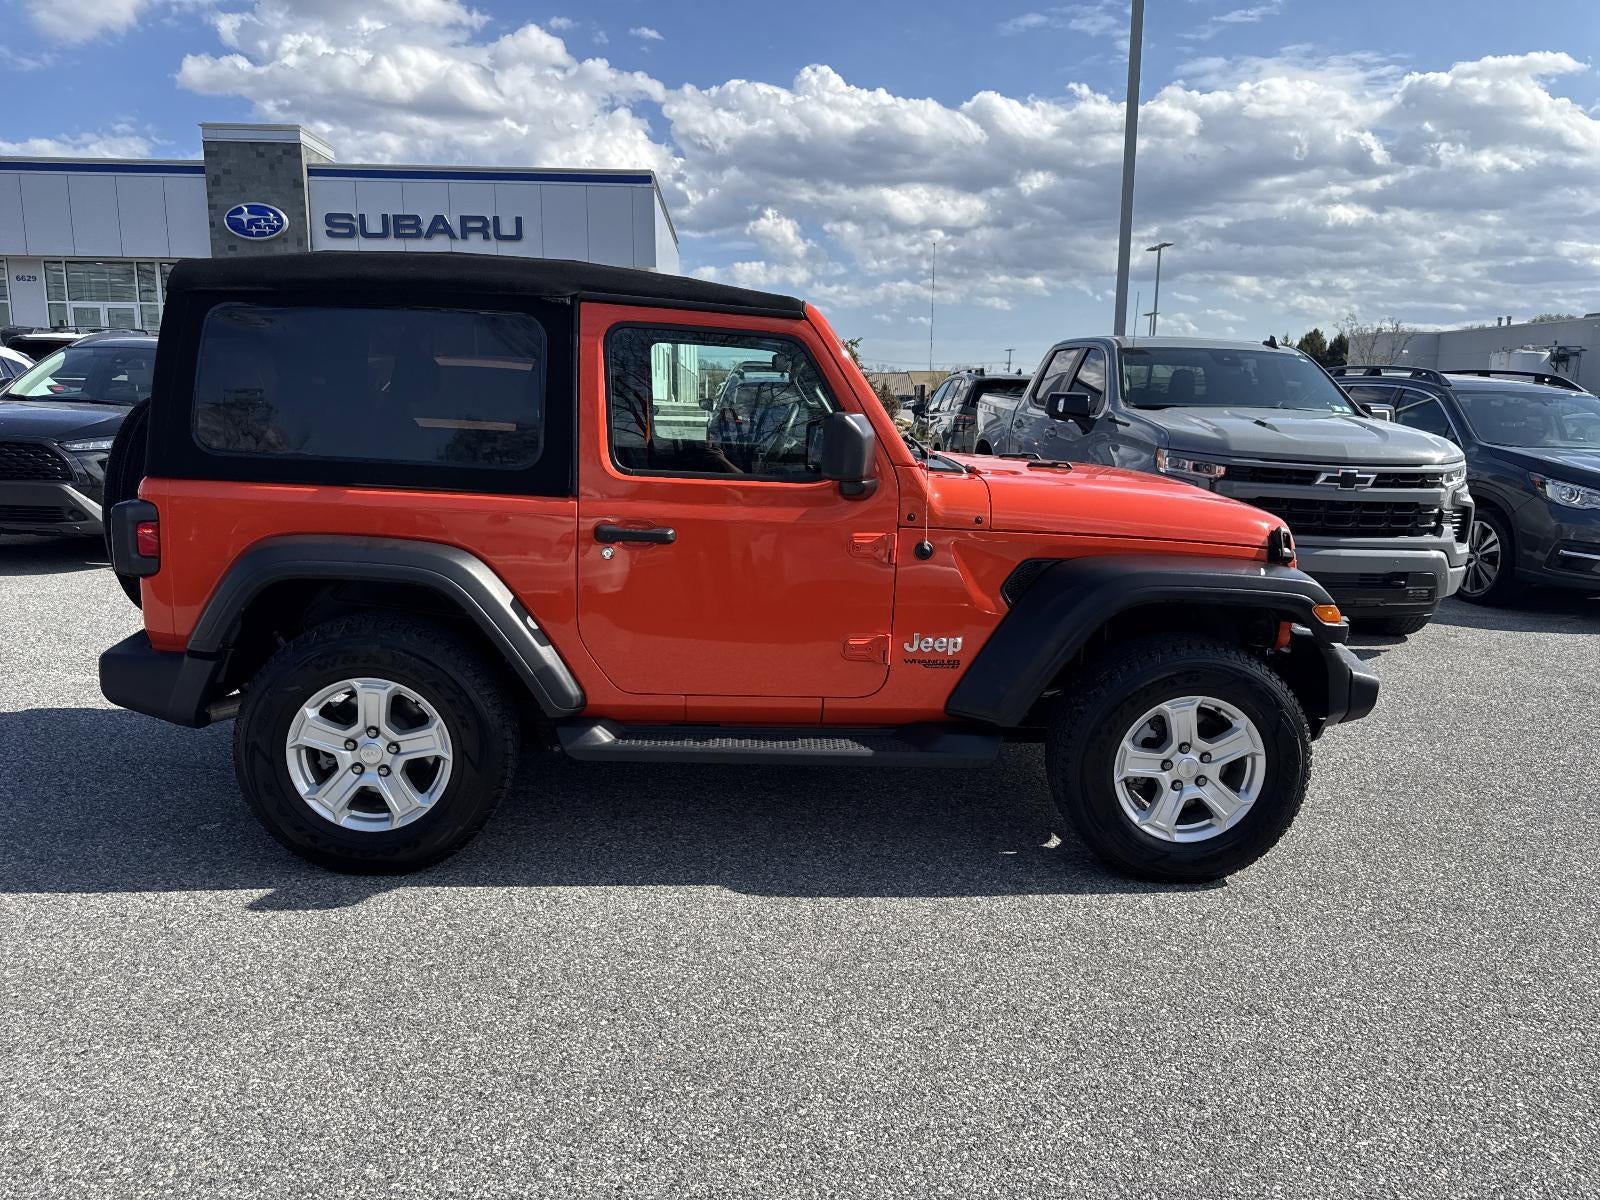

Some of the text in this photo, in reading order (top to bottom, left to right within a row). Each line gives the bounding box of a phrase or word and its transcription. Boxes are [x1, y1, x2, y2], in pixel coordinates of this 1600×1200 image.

[324, 212, 523, 241] SUBARU
[15, 274, 37, 282] 6629
[903, 632, 963, 656] Jeep
[903, 658, 961, 666] WRANGLER
